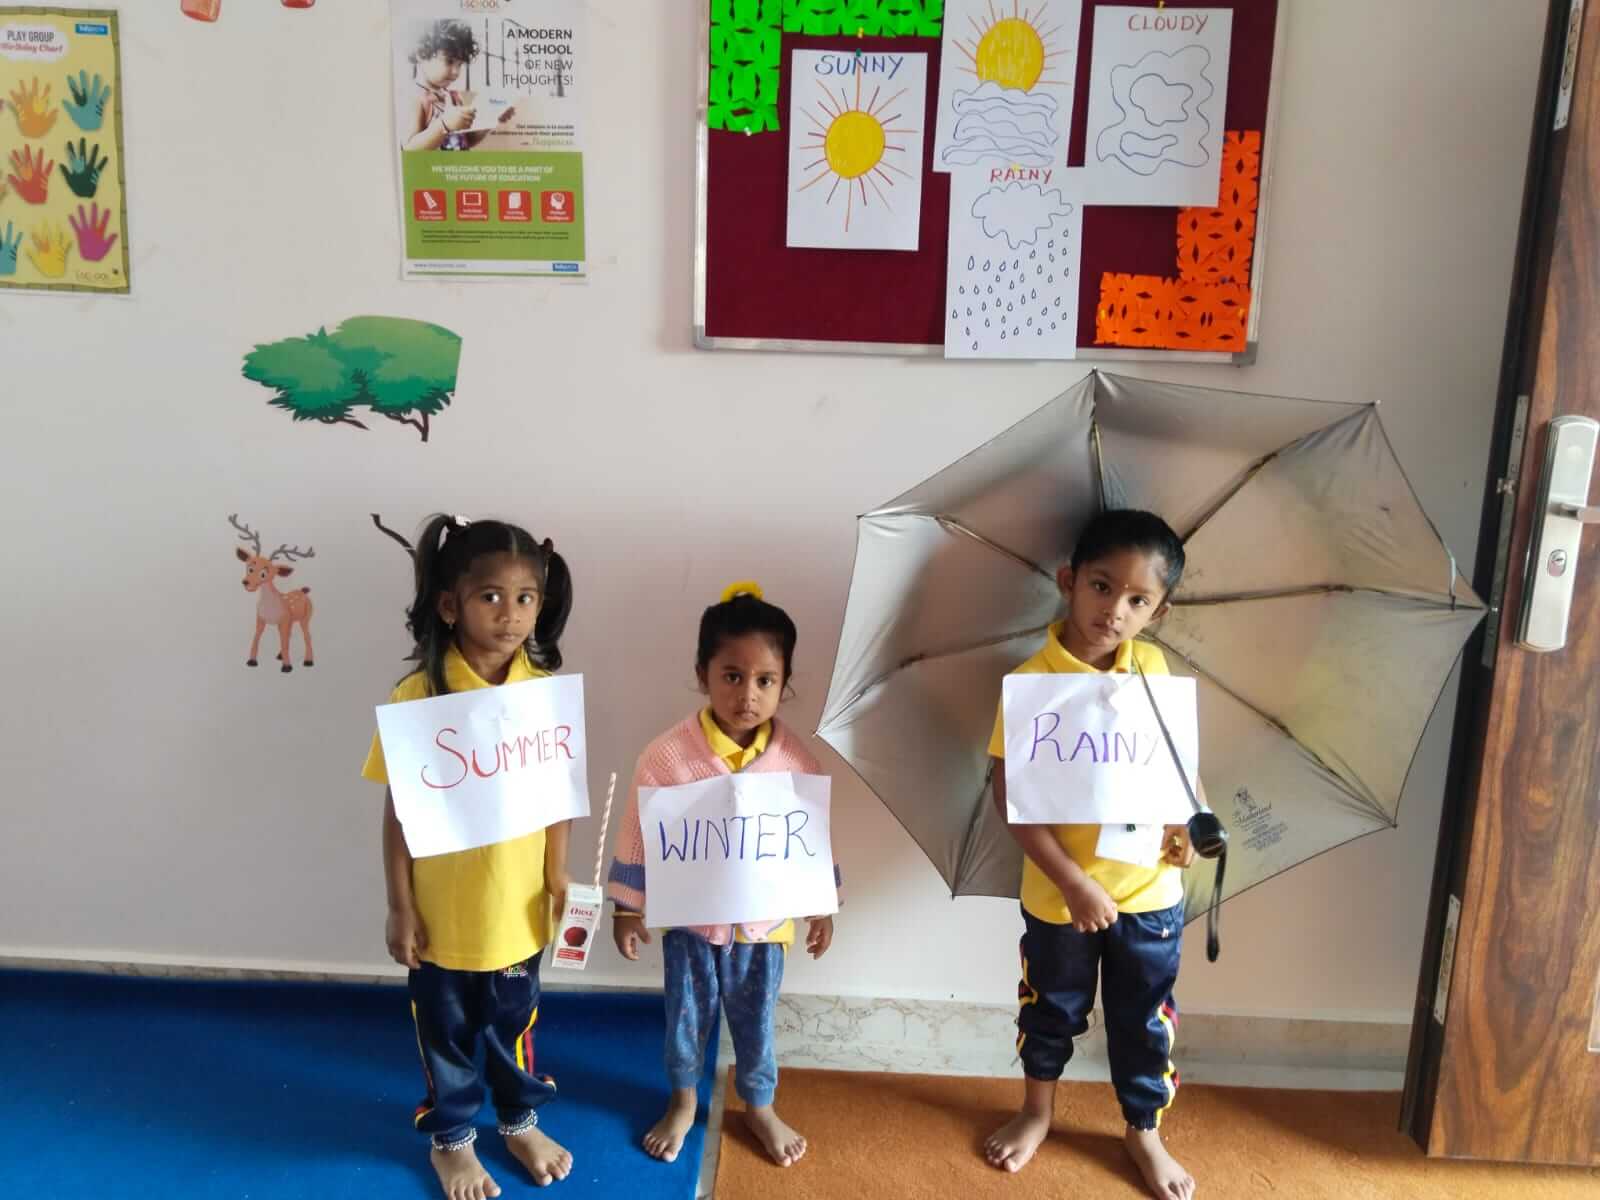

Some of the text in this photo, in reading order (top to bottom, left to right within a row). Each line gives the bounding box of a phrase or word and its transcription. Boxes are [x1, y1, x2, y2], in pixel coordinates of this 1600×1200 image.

[1128, 14, 1209, 33] CLOUDY
[7, 30, 55, 42] PLAY GROUP
[506, 29, 573, 40] A MODERN
[523, 44, 573, 55] SCHOOL
[525, 59, 573, 71] OF NEW
[814, 55, 904, 80] SUNNY
[504, 74, 574, 86] THOUGHTS!
[989, 168, 1053, 184] RAINY
[1030, 711, 1160, 766] RAINY
[420, 725, 577, 790] SUMMER
[659, 810, 817, 862] WINTER
